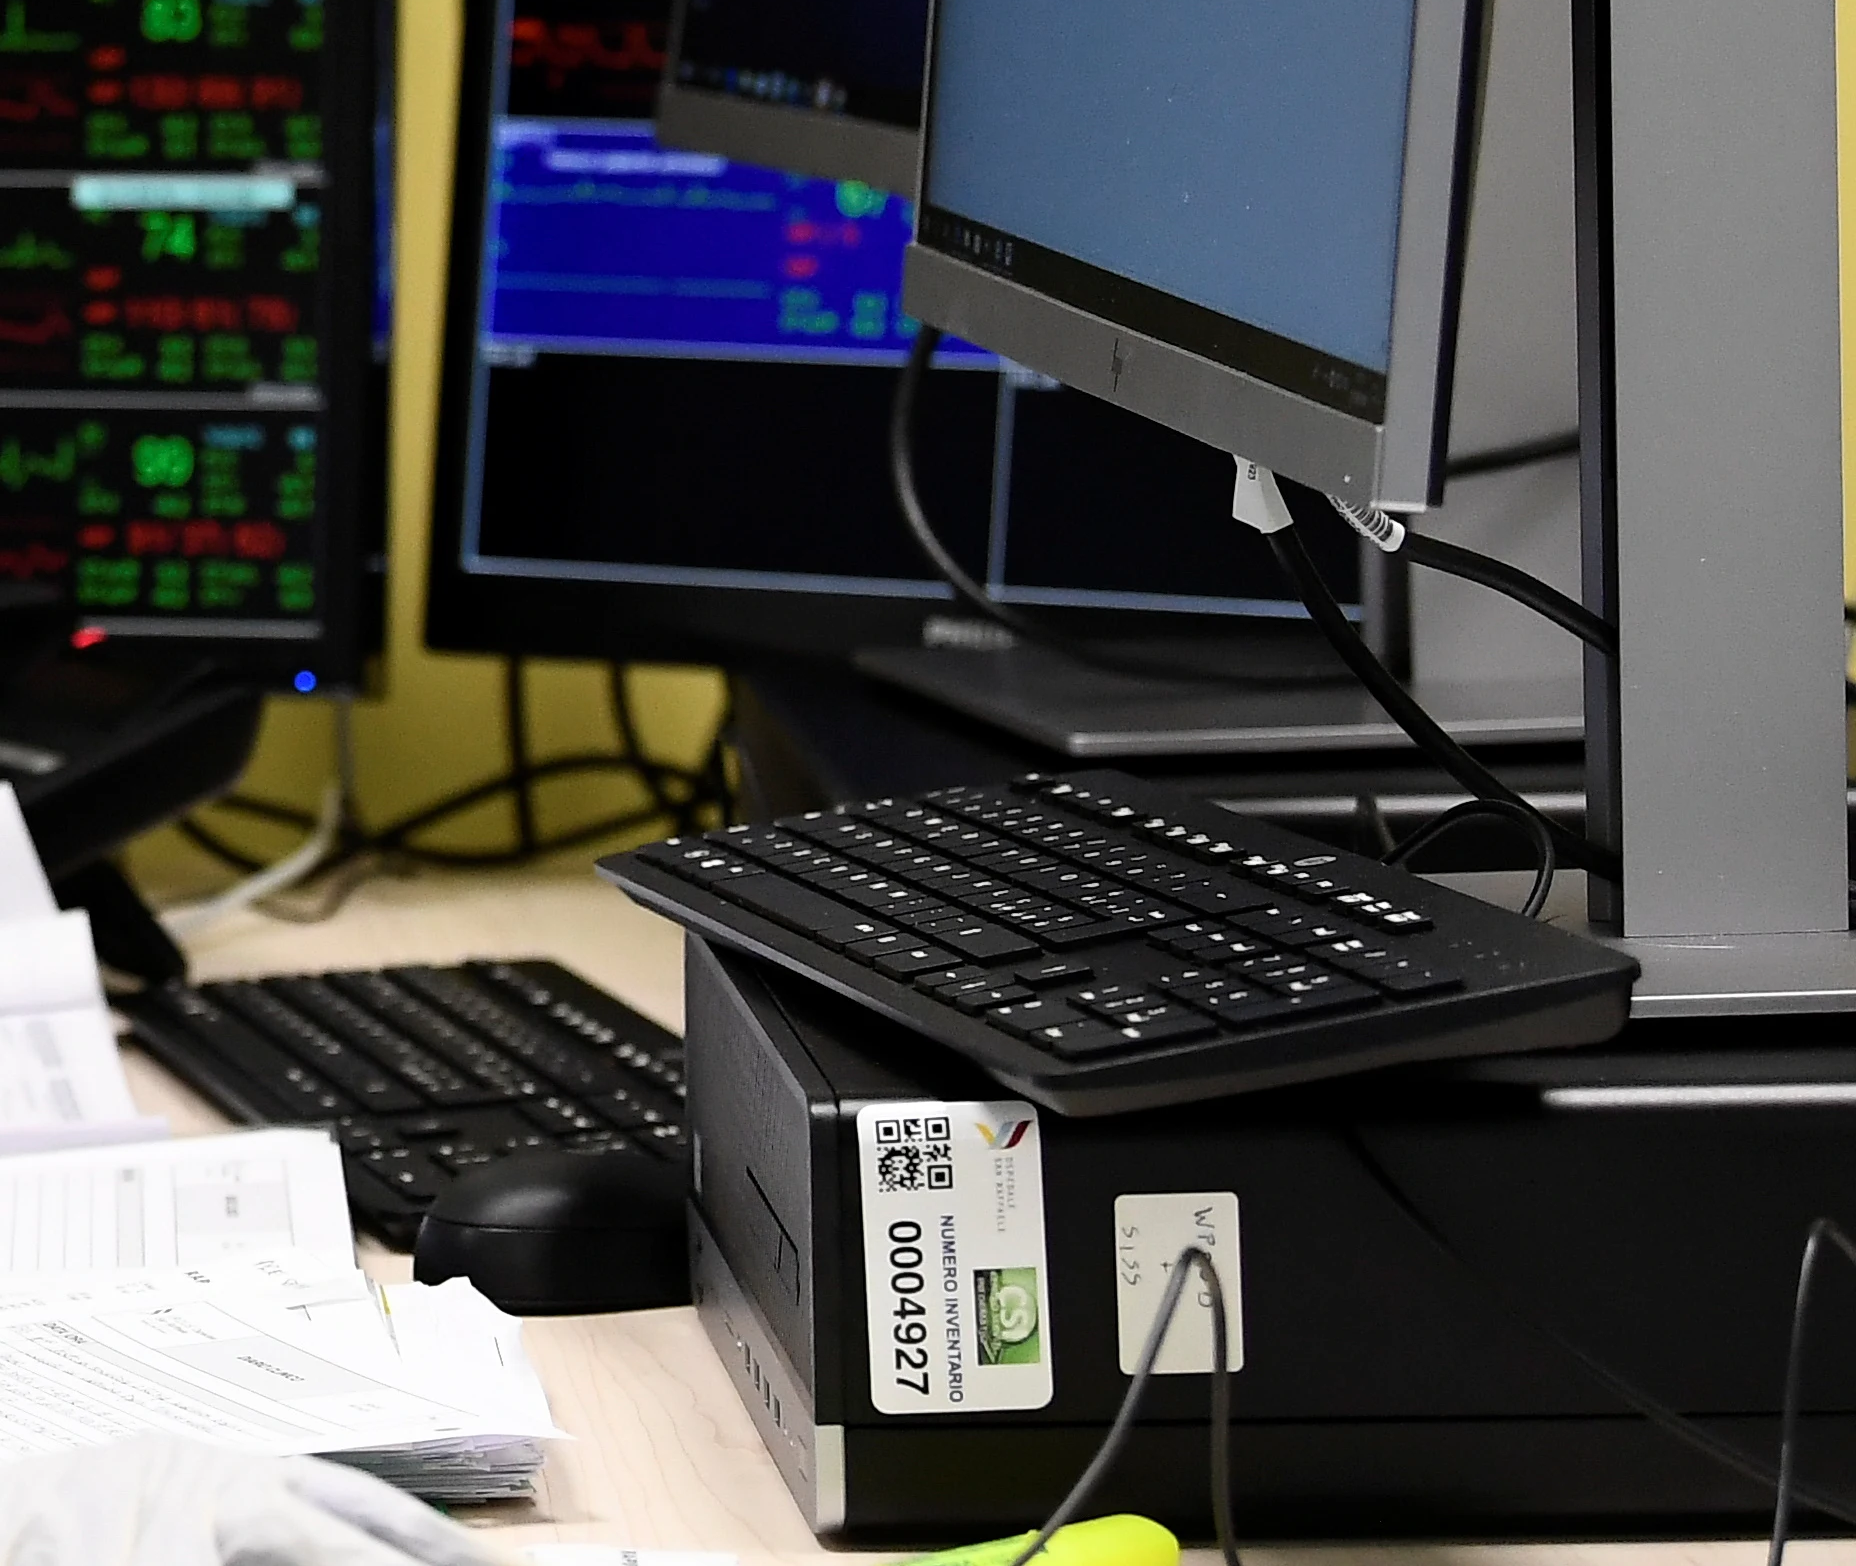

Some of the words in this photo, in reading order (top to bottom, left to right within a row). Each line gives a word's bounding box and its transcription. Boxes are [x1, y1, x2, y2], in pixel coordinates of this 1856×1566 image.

[940, 1215, 958, 1292] NUMERO
[888, 1220, 930, 1396] 0004927
[944, 1298, 964, 1403] INVENTARIO
[999, 1285, 1030, 1341] CSI
